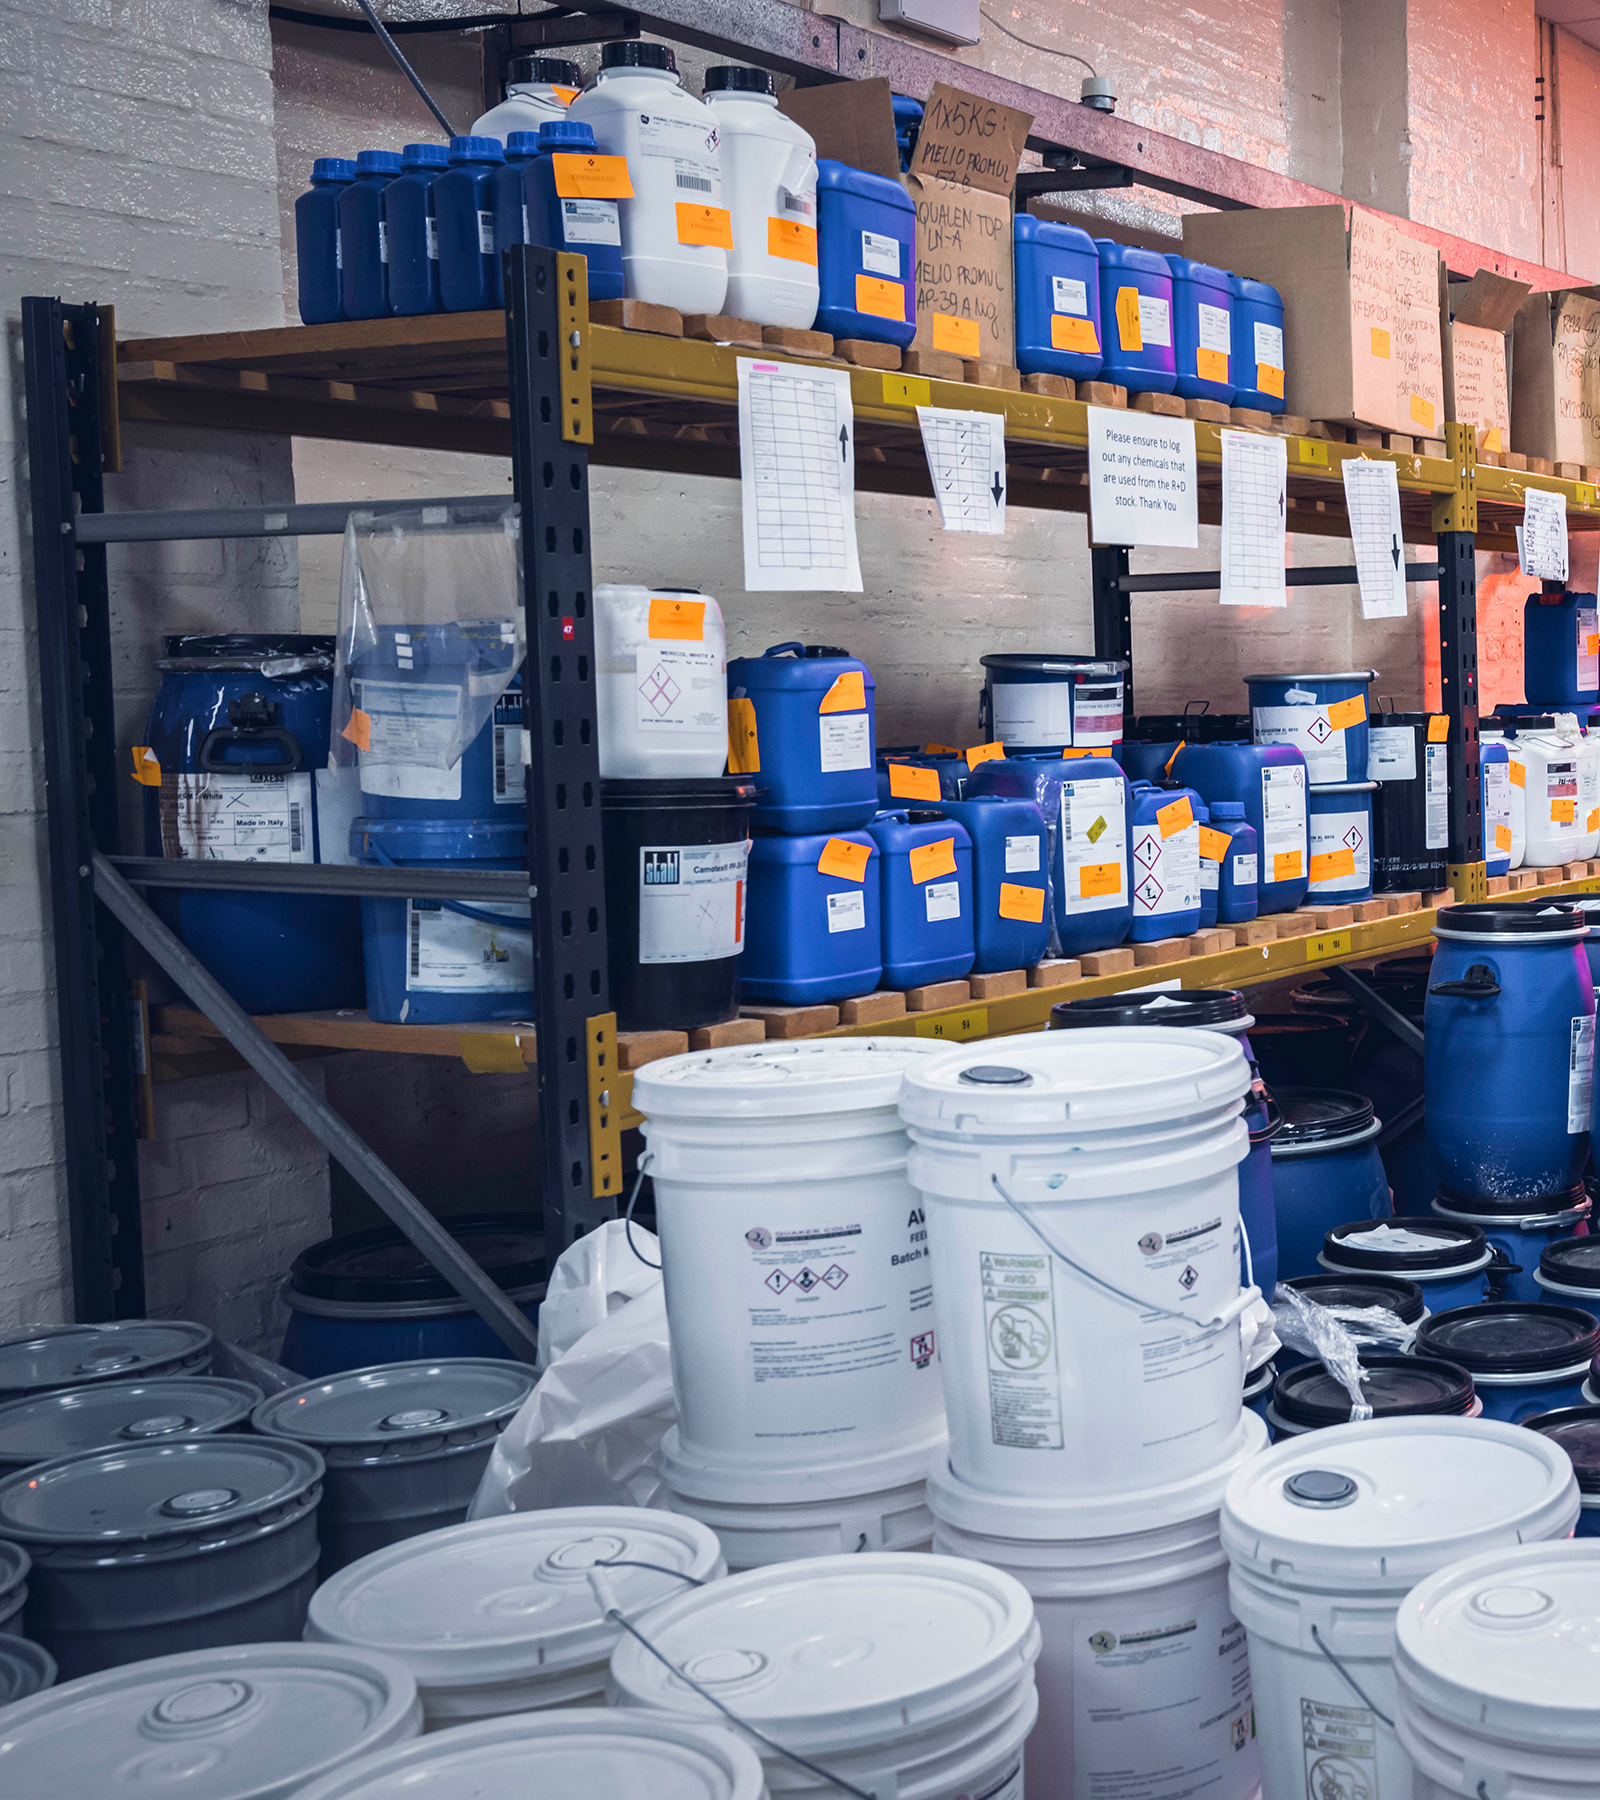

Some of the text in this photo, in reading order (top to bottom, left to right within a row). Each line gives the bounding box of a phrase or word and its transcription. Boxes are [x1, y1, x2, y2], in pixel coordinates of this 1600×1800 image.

[922, 141, 1011, 185] MELIO PROMUL
[977, 213, 1003, 242] TOP
[958, 265, 1005, 292] PROMUL
[903, 385, 907, 395] 1
[1106, 429, 1181, 454] Please ensure to log
[1102, 452, 1186, 472] out any chemicals that
[1103, 473, 1187, 492] are used from the R+D
[1115, 495, 1177, 512] stock. Thank You
[563, 625, 573, 634] 47
[660, 650, 688, 658] MERICOL
[267, 819, 284, 827] Italy
[645, 852, 679, 884] stahl
[775, 1228, 820, 1237] QUAKER
[823, 1222, 861, 1233] COLOR
[1165, 1226, 1199, 1239] QUAKER
[1200, 1216, 1222, 1228] COLOR
[891, 1249, 922, 1266] Batch
[993, 1256, 1045, 1269] WARNING
[1003, 1273, 1037, 1285] AVISO
[1119, 1628, 1162, 1640] QUAKER
[1165, 1619, 1197, 1632] COLOR
[1219, 1636, 1242, 1657] Batch
